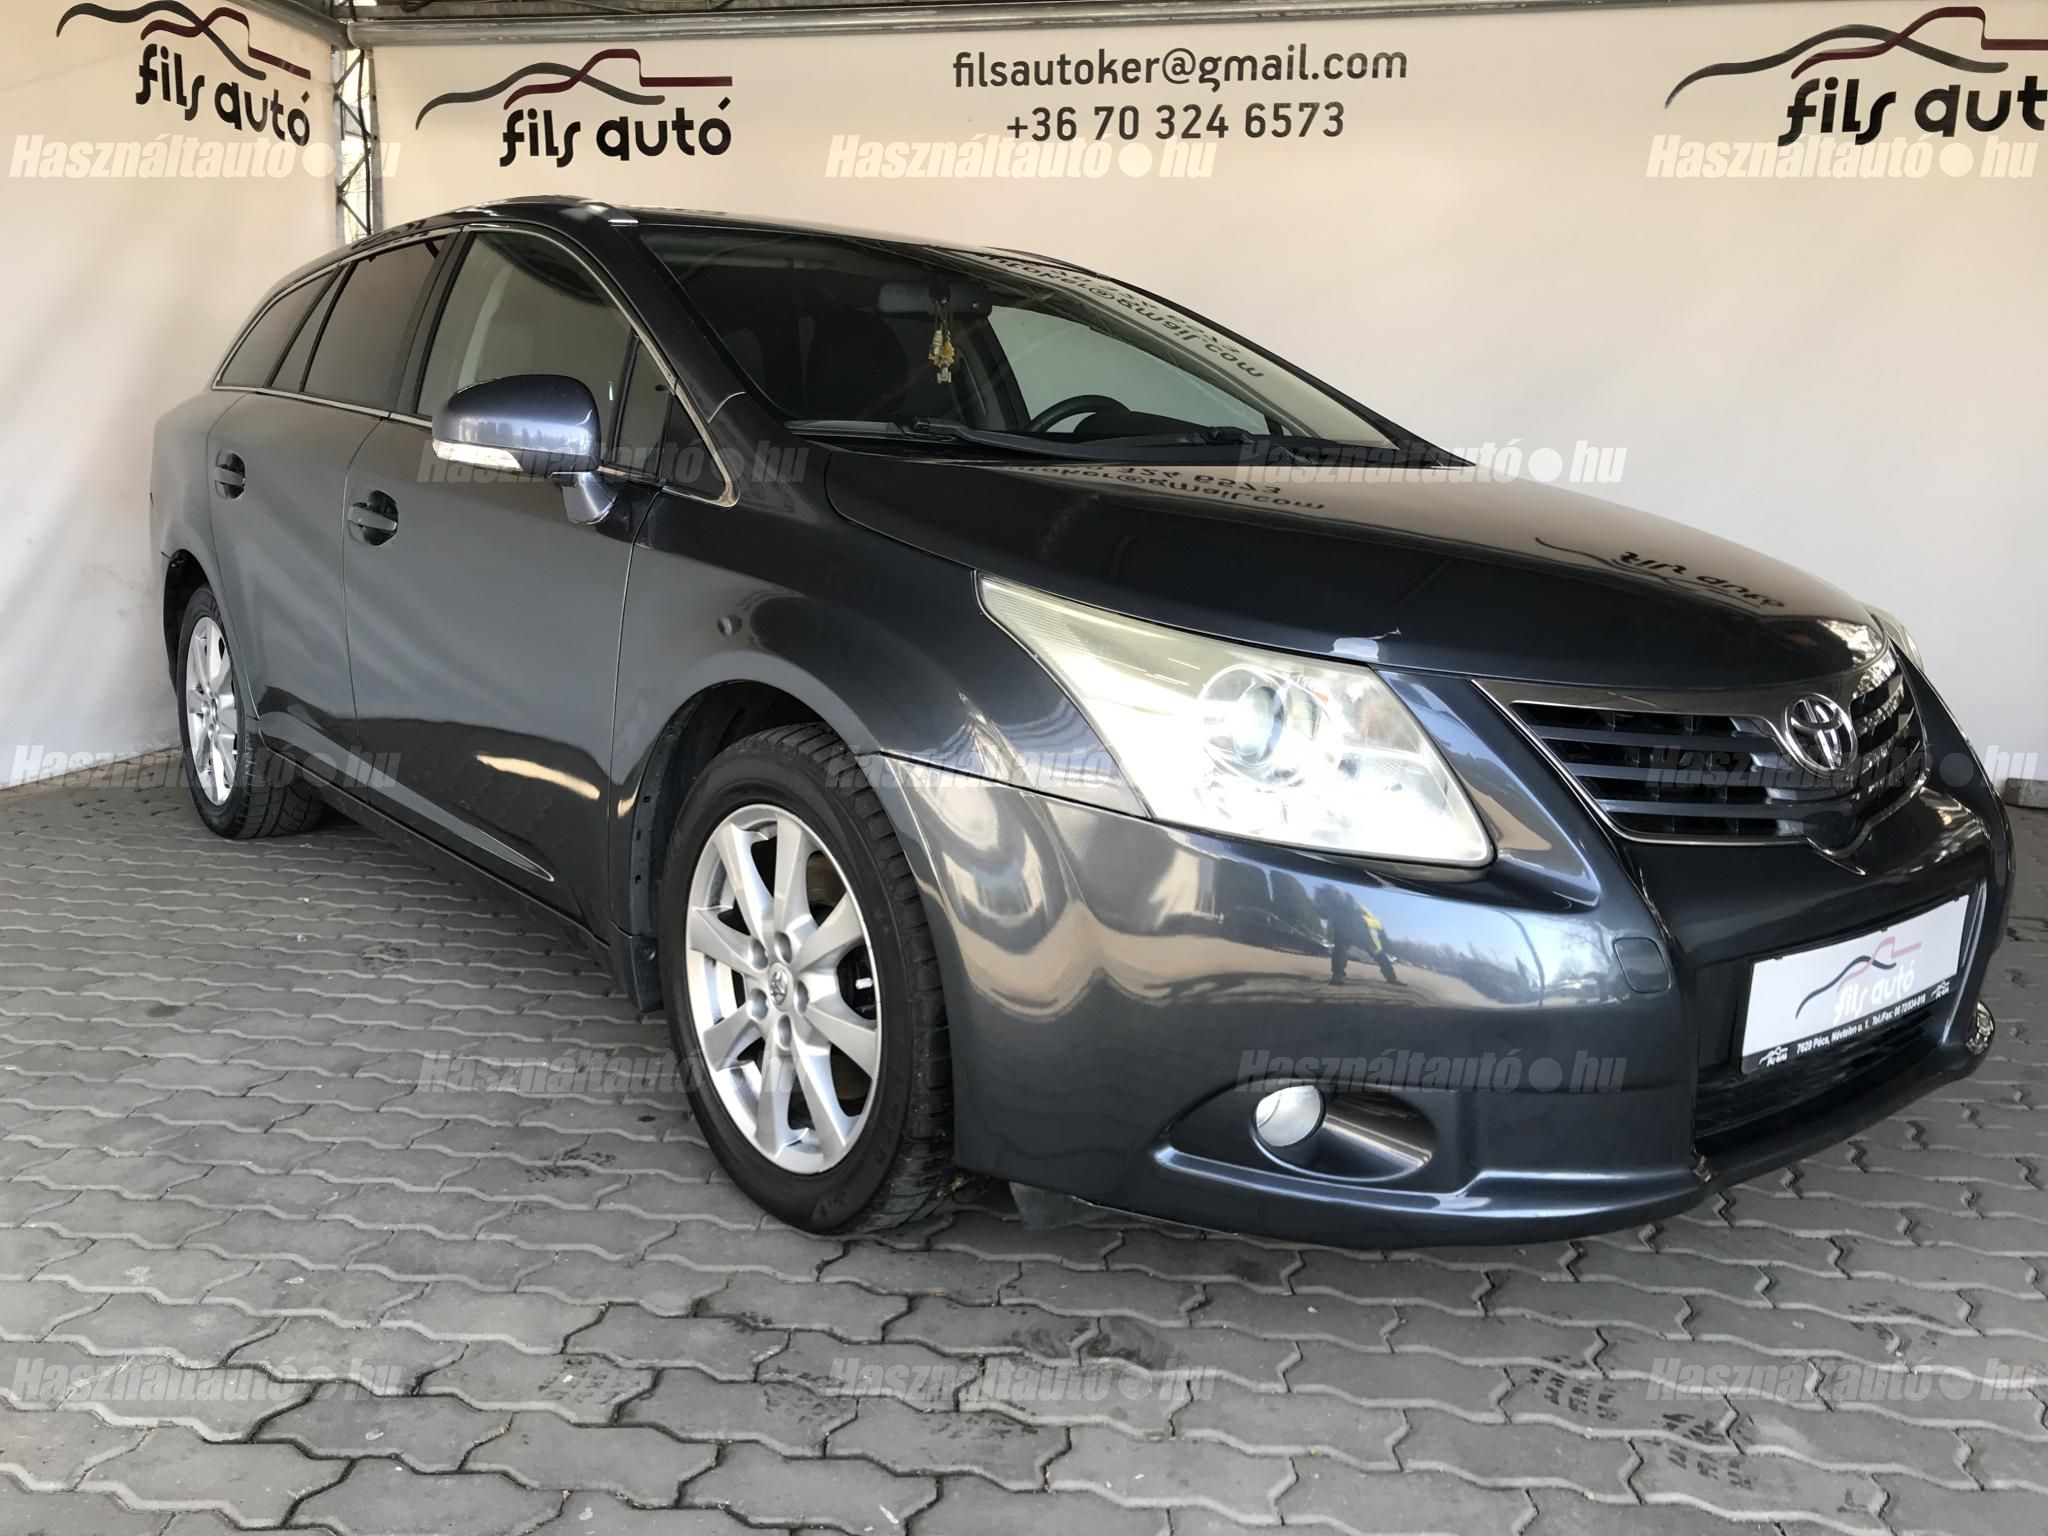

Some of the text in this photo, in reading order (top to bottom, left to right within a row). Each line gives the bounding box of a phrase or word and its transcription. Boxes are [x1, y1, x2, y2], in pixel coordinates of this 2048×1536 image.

[136, 43, 310, 147] fils autó
[953, 44, 1407, 92] filsautoker@gmail.com
[500, 97, 731, 167] fils autó
[1006, 101, 1345, 142] +36 70 324 6573
[1777, 76, 2048, 146] fils aut
[1871, 959, 1915, 1005] autó
